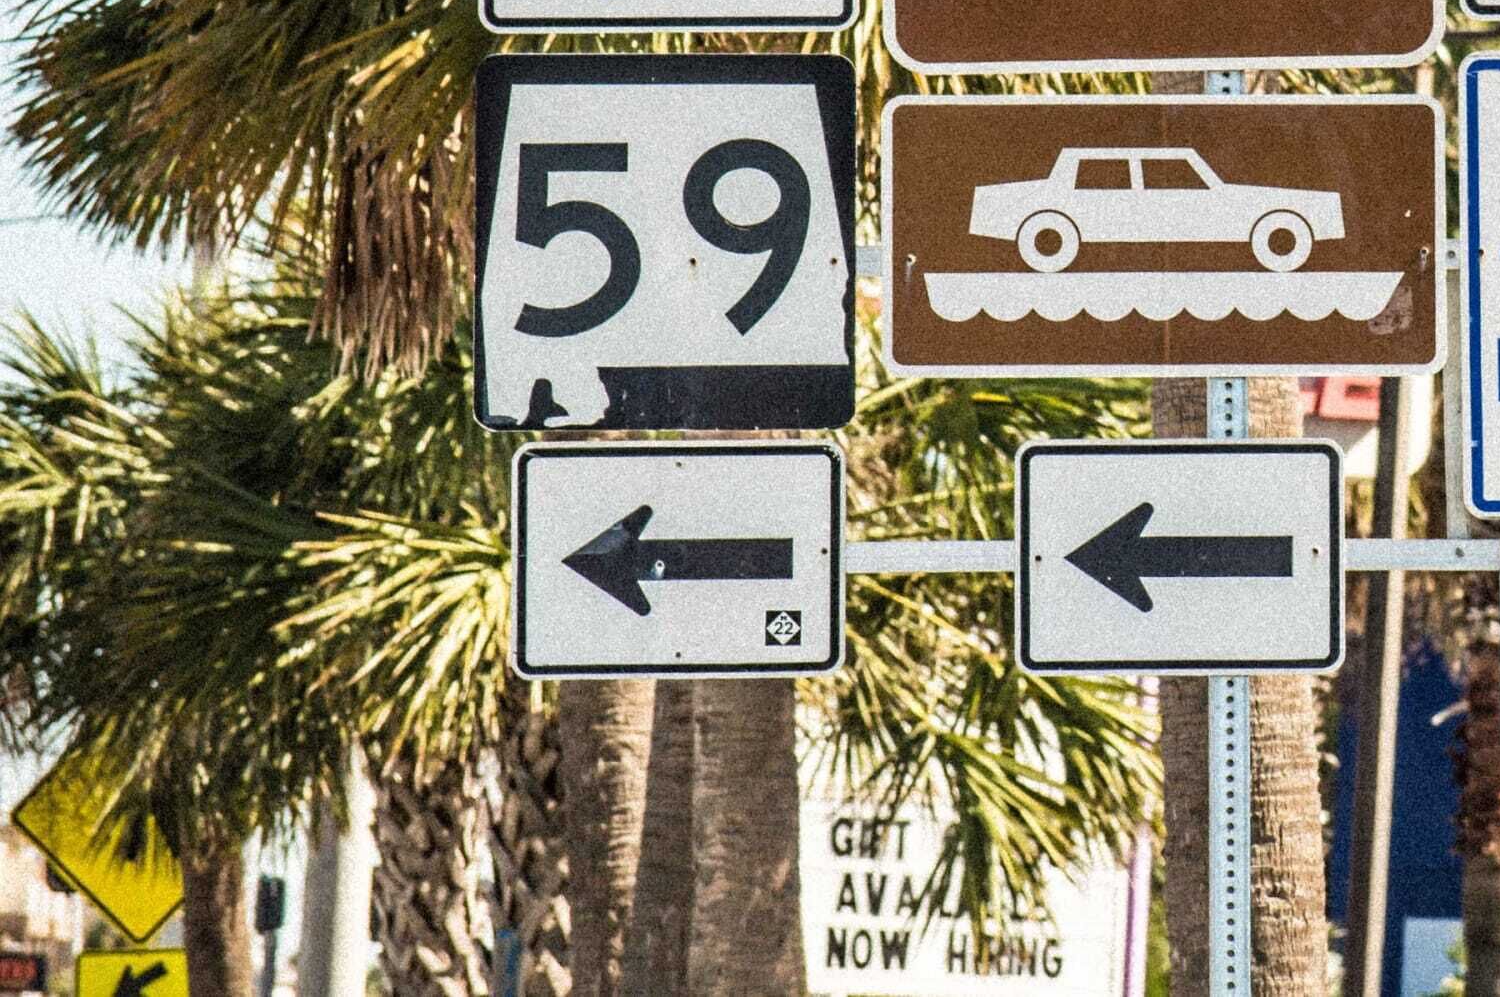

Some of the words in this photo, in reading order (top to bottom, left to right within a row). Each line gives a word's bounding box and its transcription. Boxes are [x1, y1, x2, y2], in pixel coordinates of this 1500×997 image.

[514, 138, 811, 337] 59
[774, 621, 793, 634] 22
[826, 926, 911, 971] NOW
